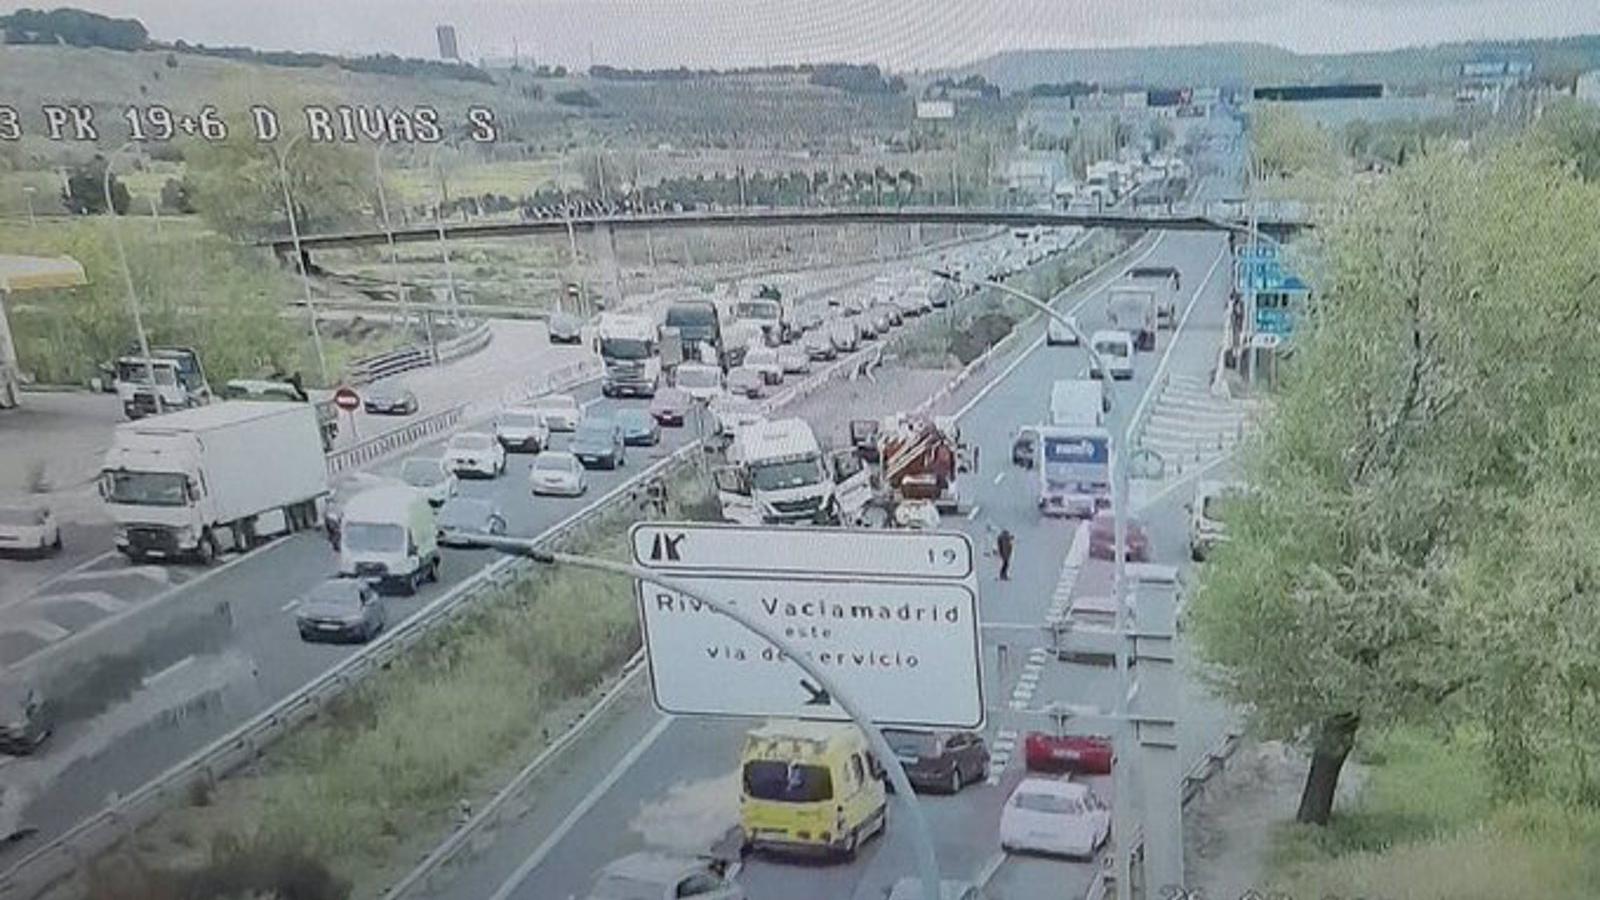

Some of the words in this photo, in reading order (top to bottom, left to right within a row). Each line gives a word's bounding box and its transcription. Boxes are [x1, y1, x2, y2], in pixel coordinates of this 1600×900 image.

[928, 549, 956, 565] 19
[762, 597, 959, 623] Vaciamadrid
[785, 626, 831, 639] este
[806, 650, 919, 668] ervicio
